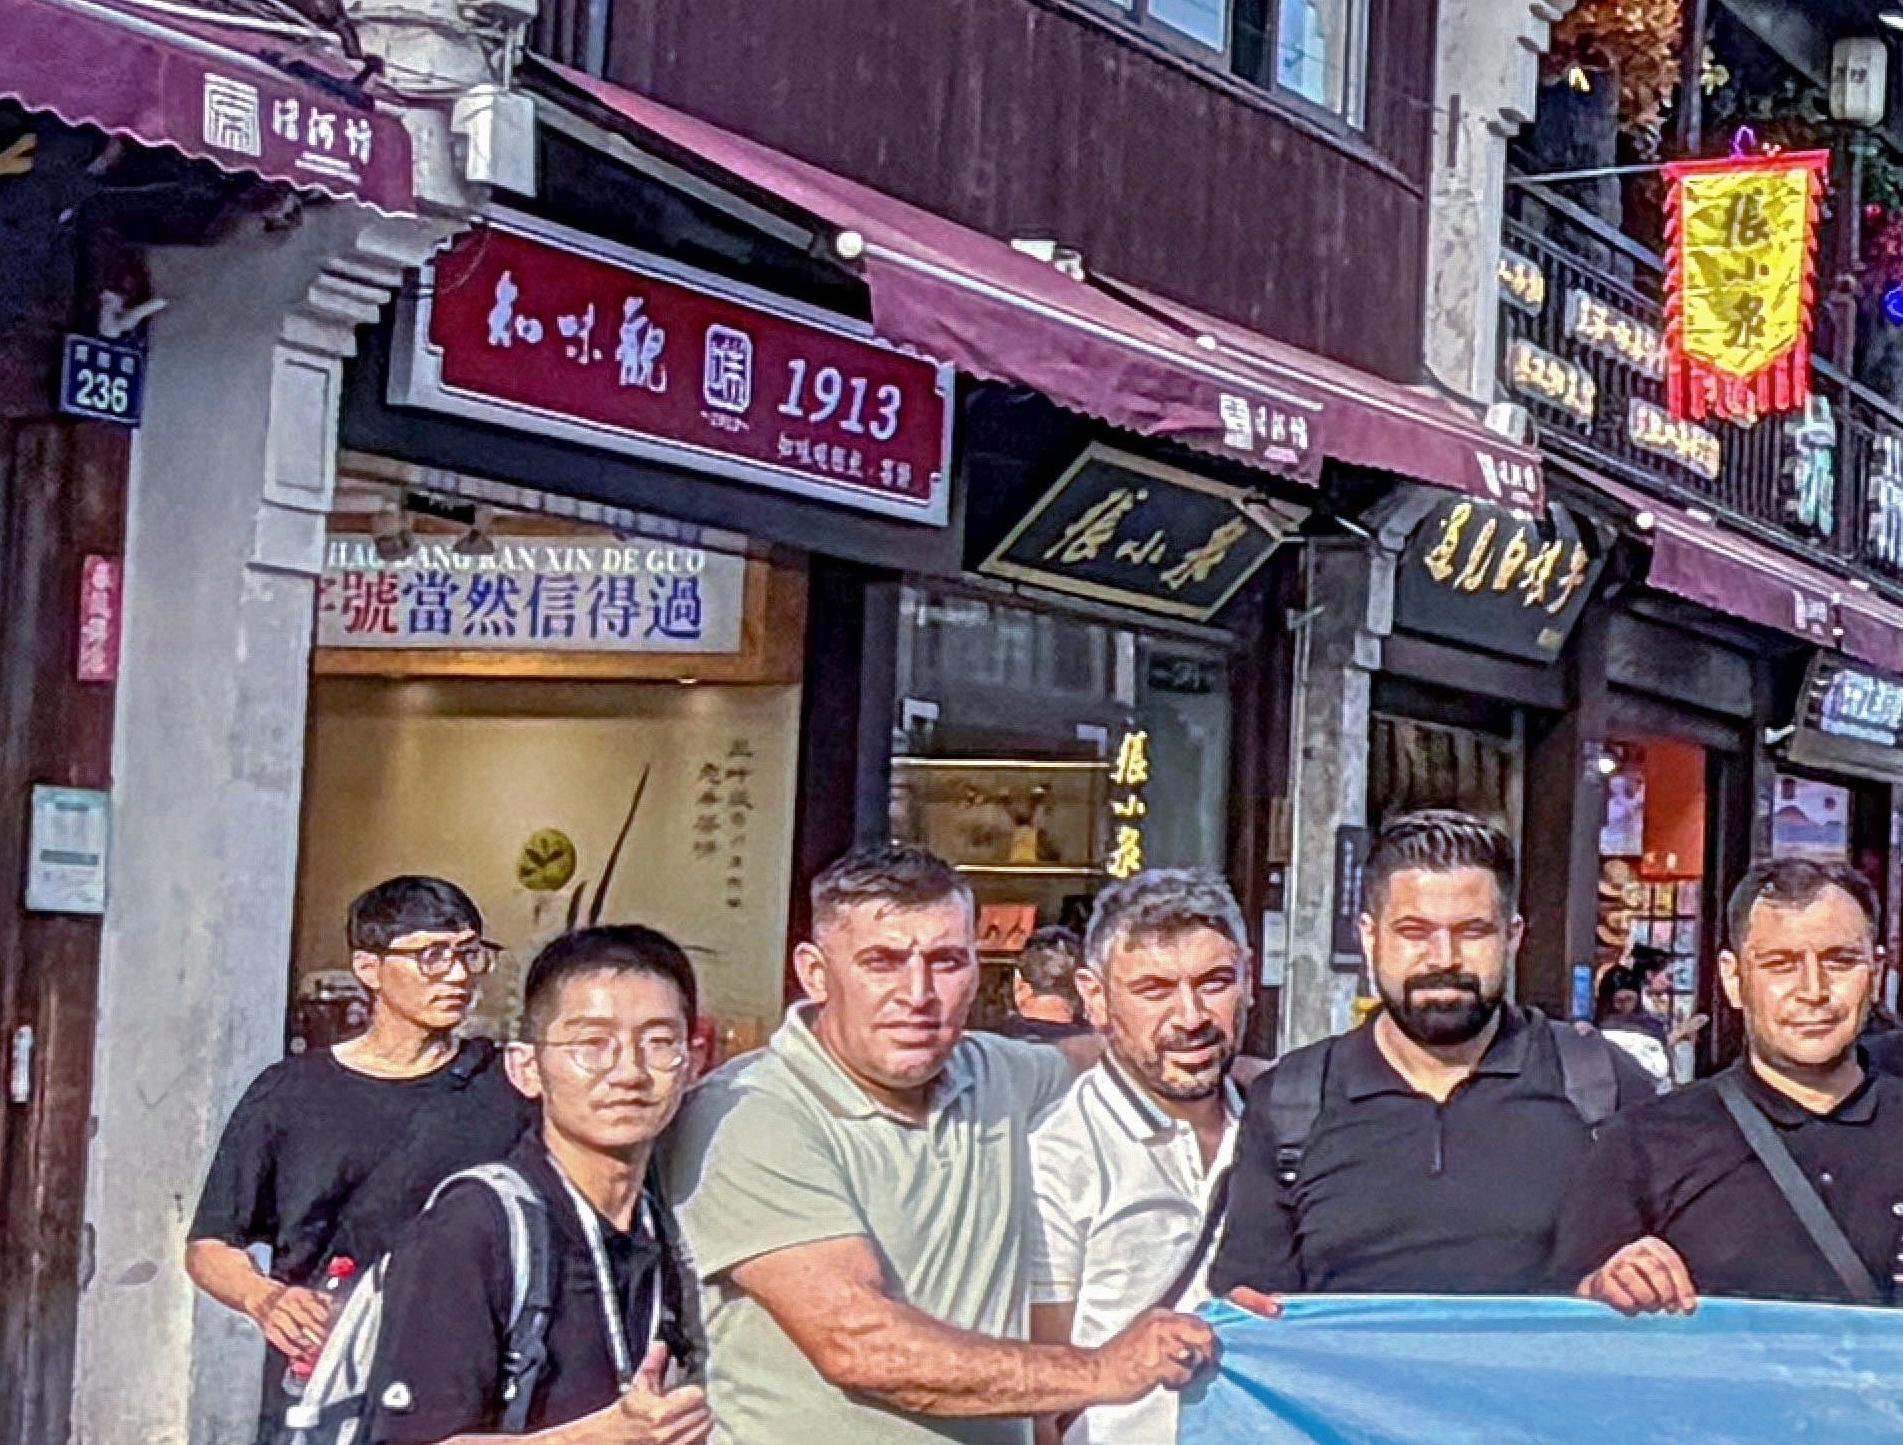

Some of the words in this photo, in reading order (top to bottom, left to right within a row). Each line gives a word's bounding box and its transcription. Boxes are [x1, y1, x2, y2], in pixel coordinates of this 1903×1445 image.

[76, 368, 129, 414] 236
[777, 358, 901, 440] 1913
[546, 547, 594, 572] XIN
[604, 548, 638, 572] DE
[646, 548, 707, 573] GUO
